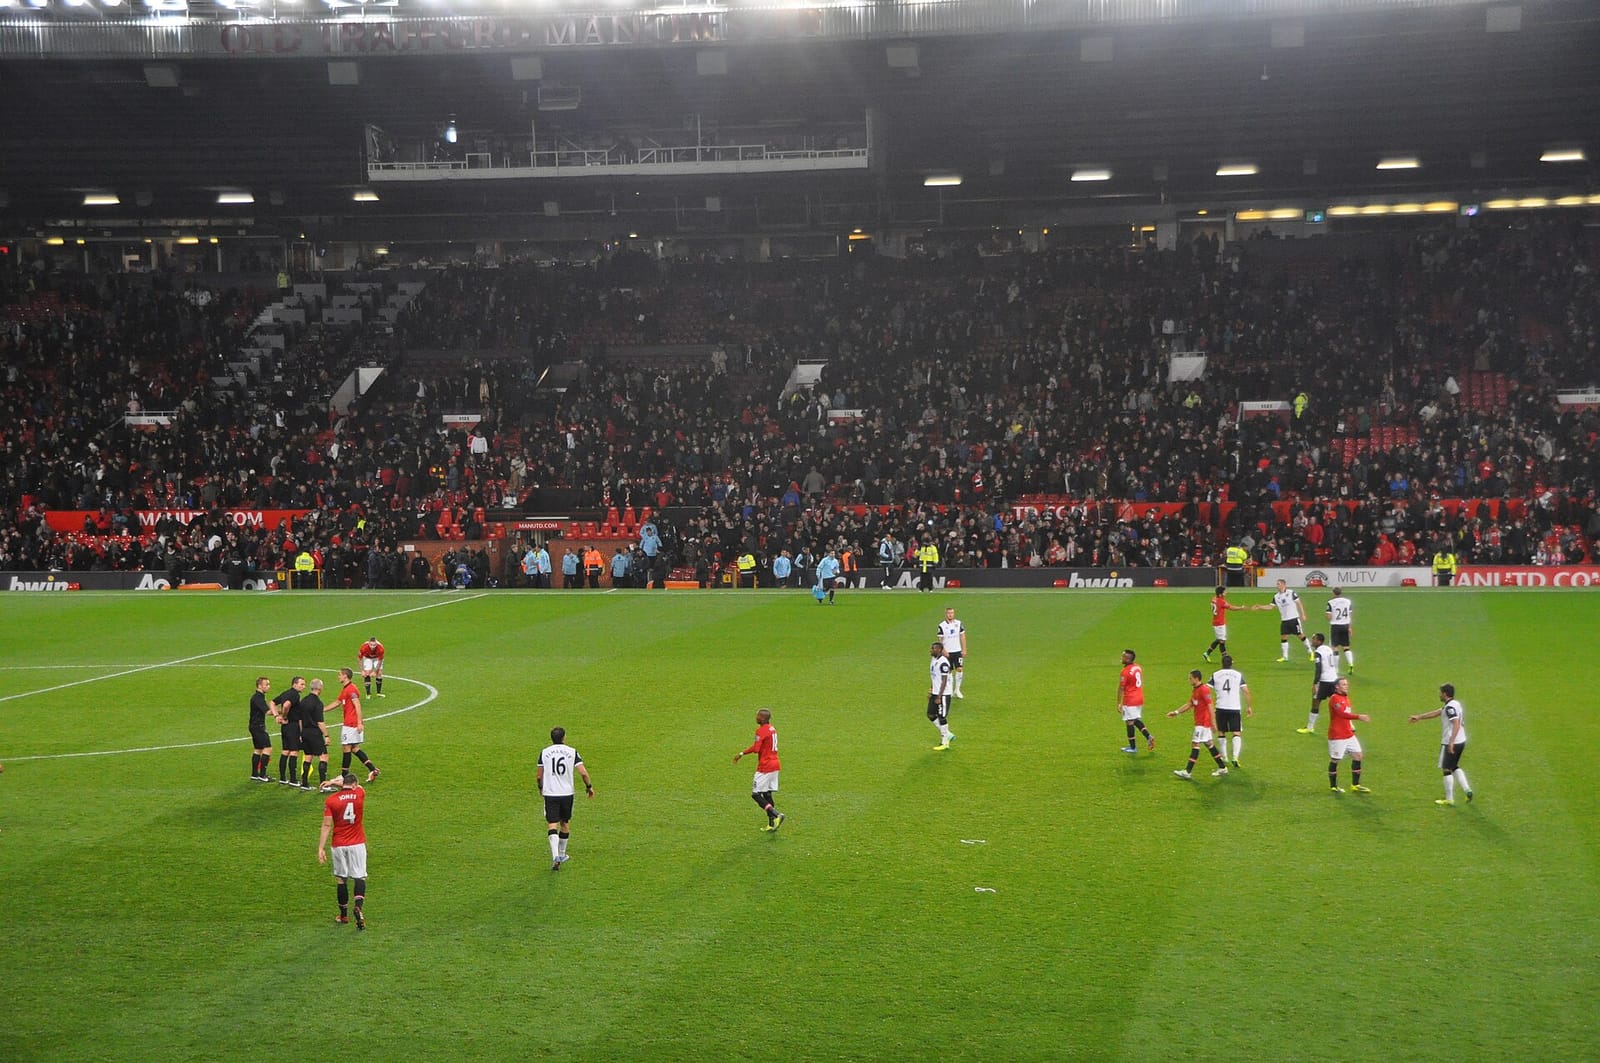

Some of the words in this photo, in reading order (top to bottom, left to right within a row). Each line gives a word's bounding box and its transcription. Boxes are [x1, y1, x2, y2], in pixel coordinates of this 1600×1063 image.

[518, 522, 558, 530] MANUTD.COM
[9, 575, 70, 592] bwin
[1068, 571, 1134, 588] bwin
[1337, 571, 1377, 583] MUTV
[1335, 607, 1348, 620] 24
[1135, 671, 1142, 688] 8
[1222, 679, 1231, 694] 4
[551, 756, 566, 776] 16
[343, 802, 356, 825] 4
